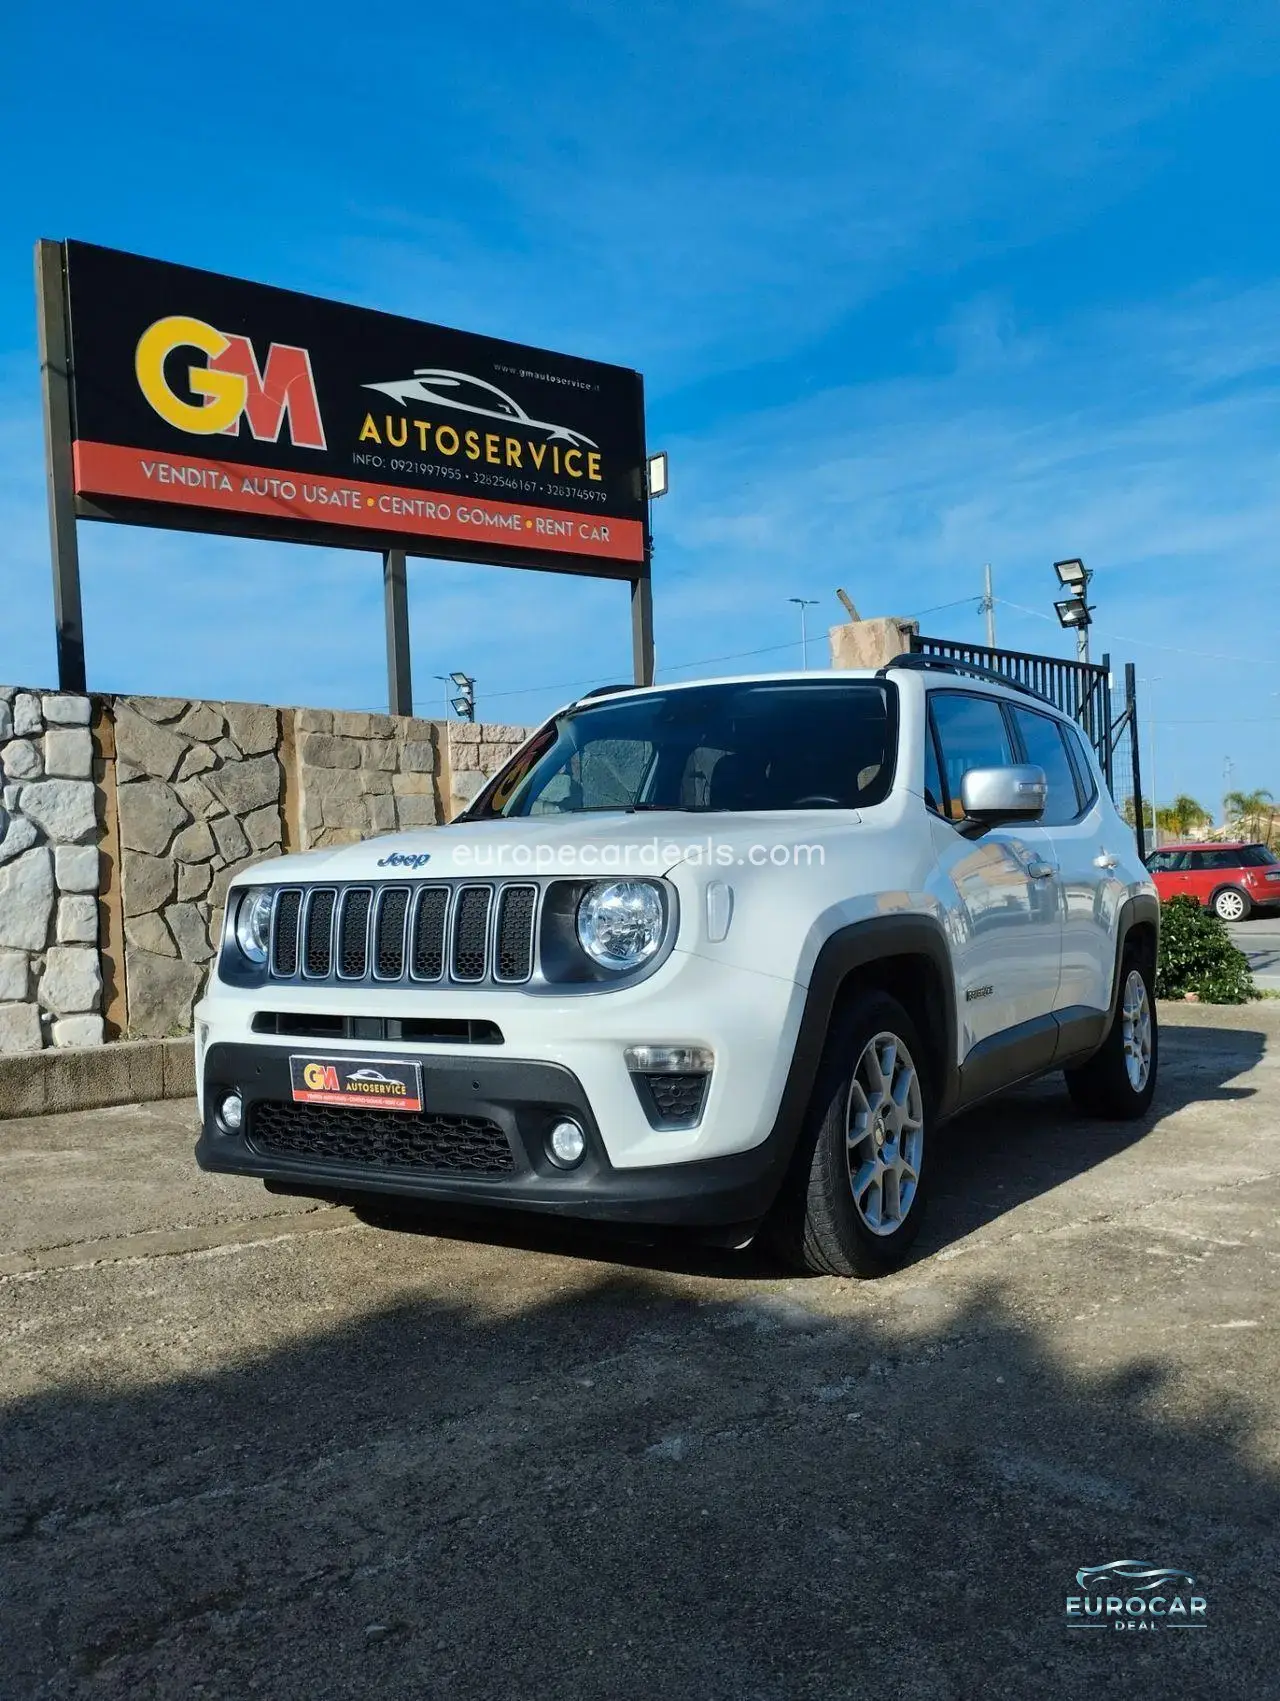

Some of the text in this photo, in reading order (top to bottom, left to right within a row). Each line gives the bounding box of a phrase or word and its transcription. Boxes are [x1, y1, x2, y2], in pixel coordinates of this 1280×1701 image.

[135, 315, 327, 451] GM
[359, 412, 602, 481] AUTOSERVICE
[352, 452, 387, 469] INFO:
[390, 458, 462, 480] 0921997955
[140, 460, 611, 543] VENDITA AUTO USATE CENTRO GOMME RENT CAR
[377, 852, 431, 870] Jeep
[303, 1062, 340, 1091] GM
[346, 1082, 407, 1096] AUTOSERVICE
